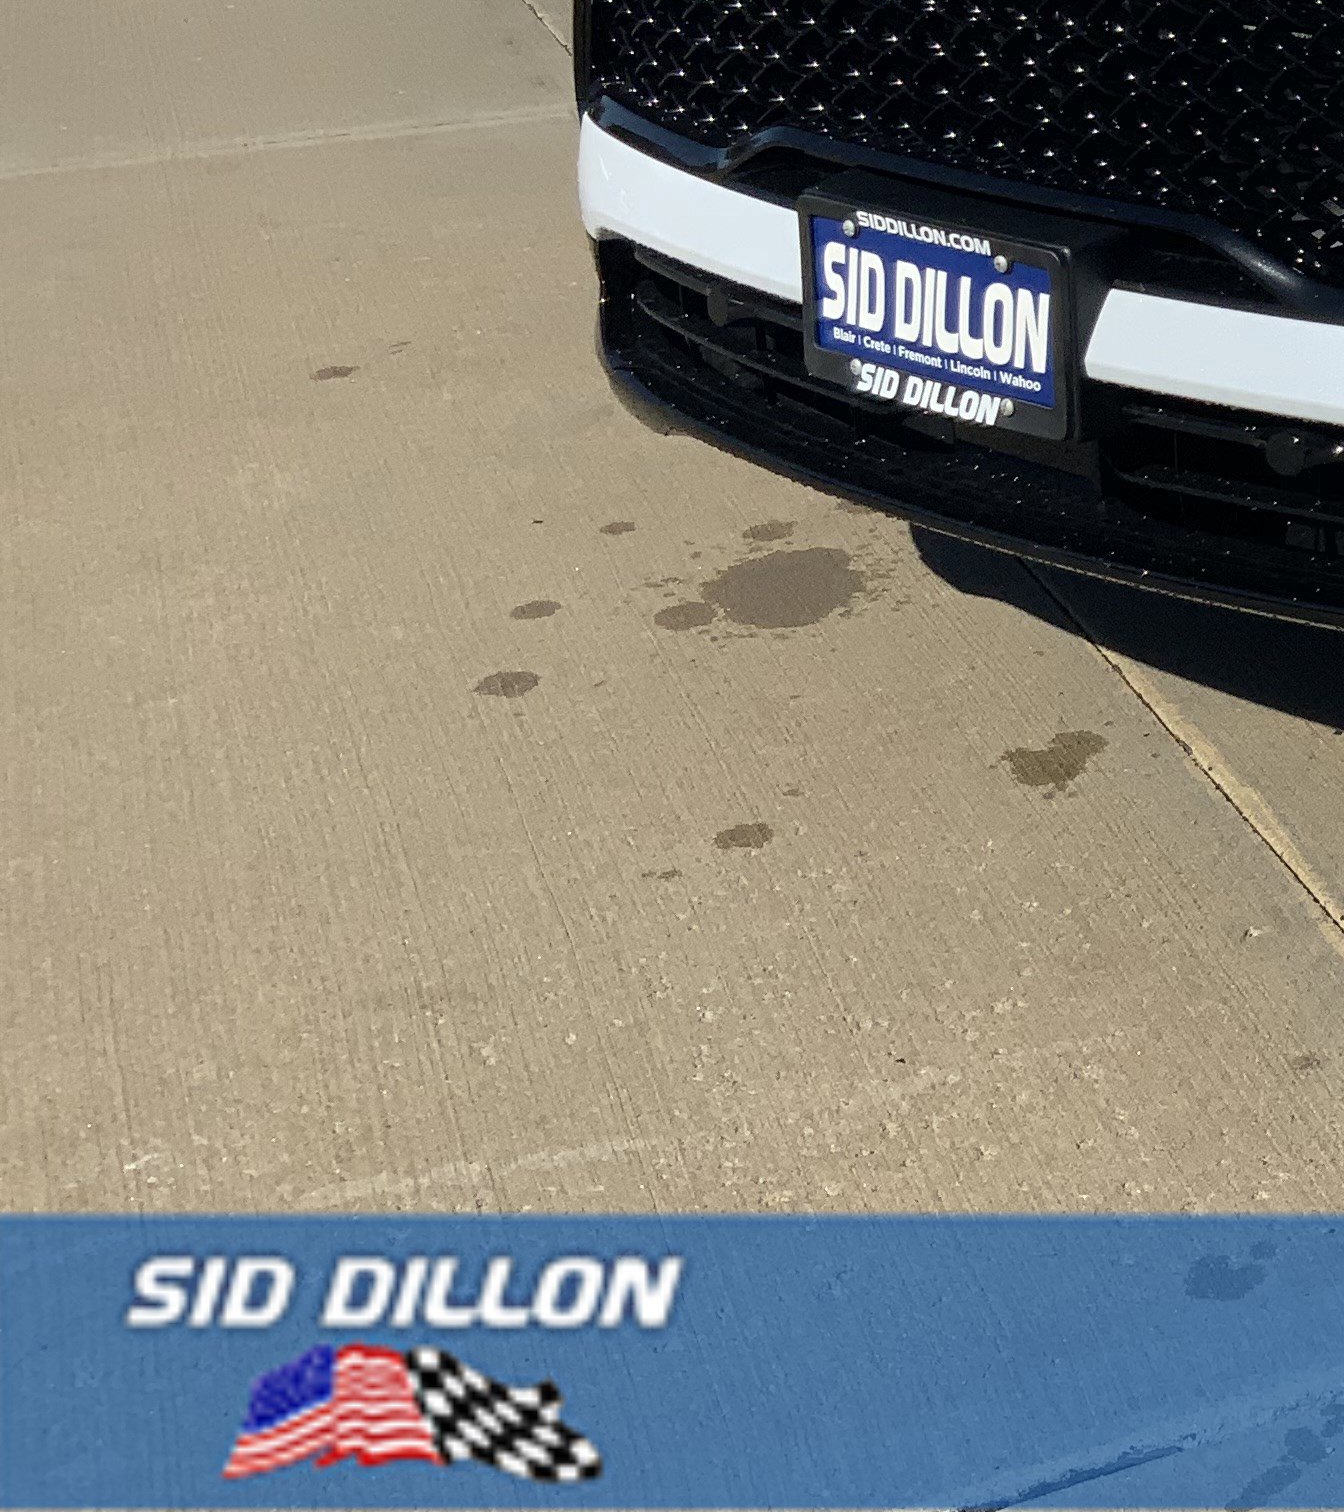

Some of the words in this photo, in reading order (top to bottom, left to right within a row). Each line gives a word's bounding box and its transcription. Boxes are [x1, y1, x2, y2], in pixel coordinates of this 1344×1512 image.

[856, 210, 992, 257] SIDDILLON.COM
[822, 241, 886, 332] SID
[895, 259, 1051, 374] DILLON
[833, 326, 857, 346] Blair
[863, 335, 891, 355] Crete
[898, 345, 943, 369] Fremont
[950, 359, 991, 381] Lincoln
[999, 370, 1042, 393] Wahoo
[856, 362, 900, 400] SID
[903, 375, 1002, 427] DILLON
